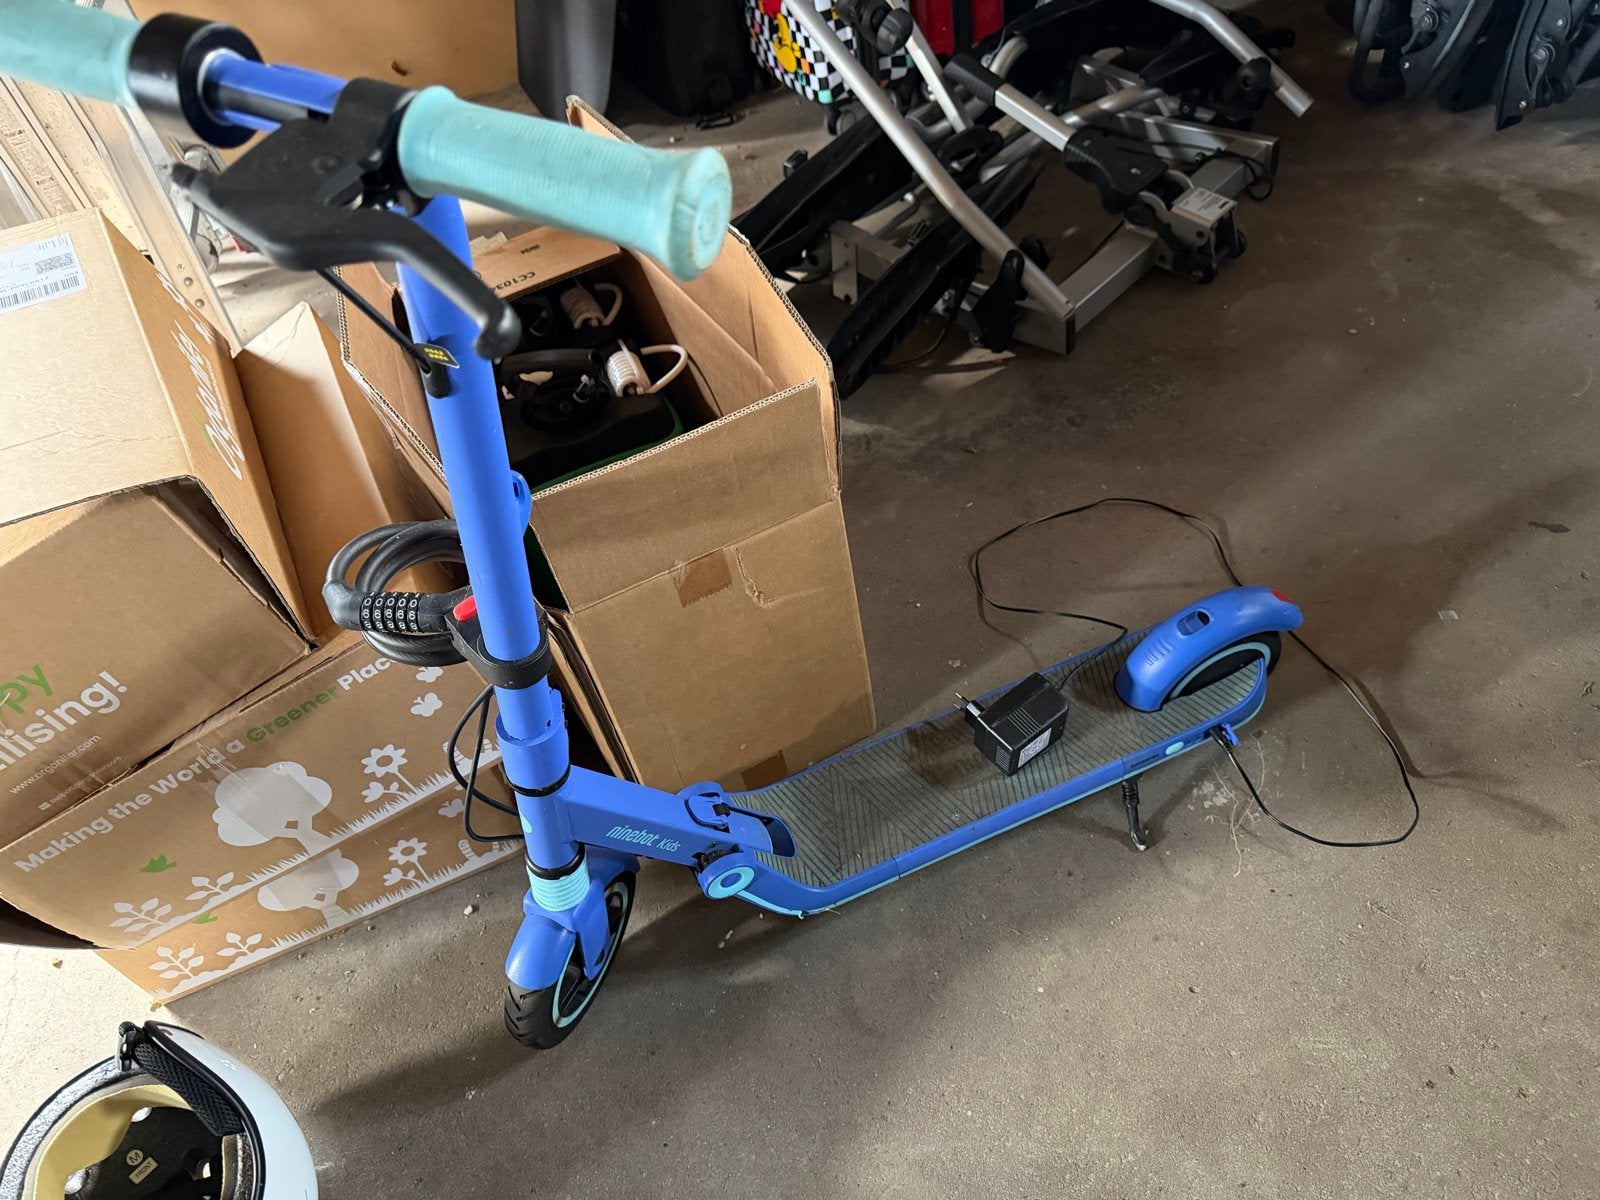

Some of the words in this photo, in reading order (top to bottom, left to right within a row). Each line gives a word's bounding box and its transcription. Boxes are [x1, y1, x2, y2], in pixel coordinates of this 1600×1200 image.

[0, 664, 53, 714] py
[14, 816, 114, 873] Making
[107, 792, 153, 819] the
[149, 747, 226, 795] World
[226, 739, 245, 753] a
[246, 686, 337, 742] Greener
[336, 657, 398, 691] Plac
[606, 825, 660, 847] ninebot
[128, 1152, 141, 1164] M
[135, 1161, 152, 1178] FRONT
